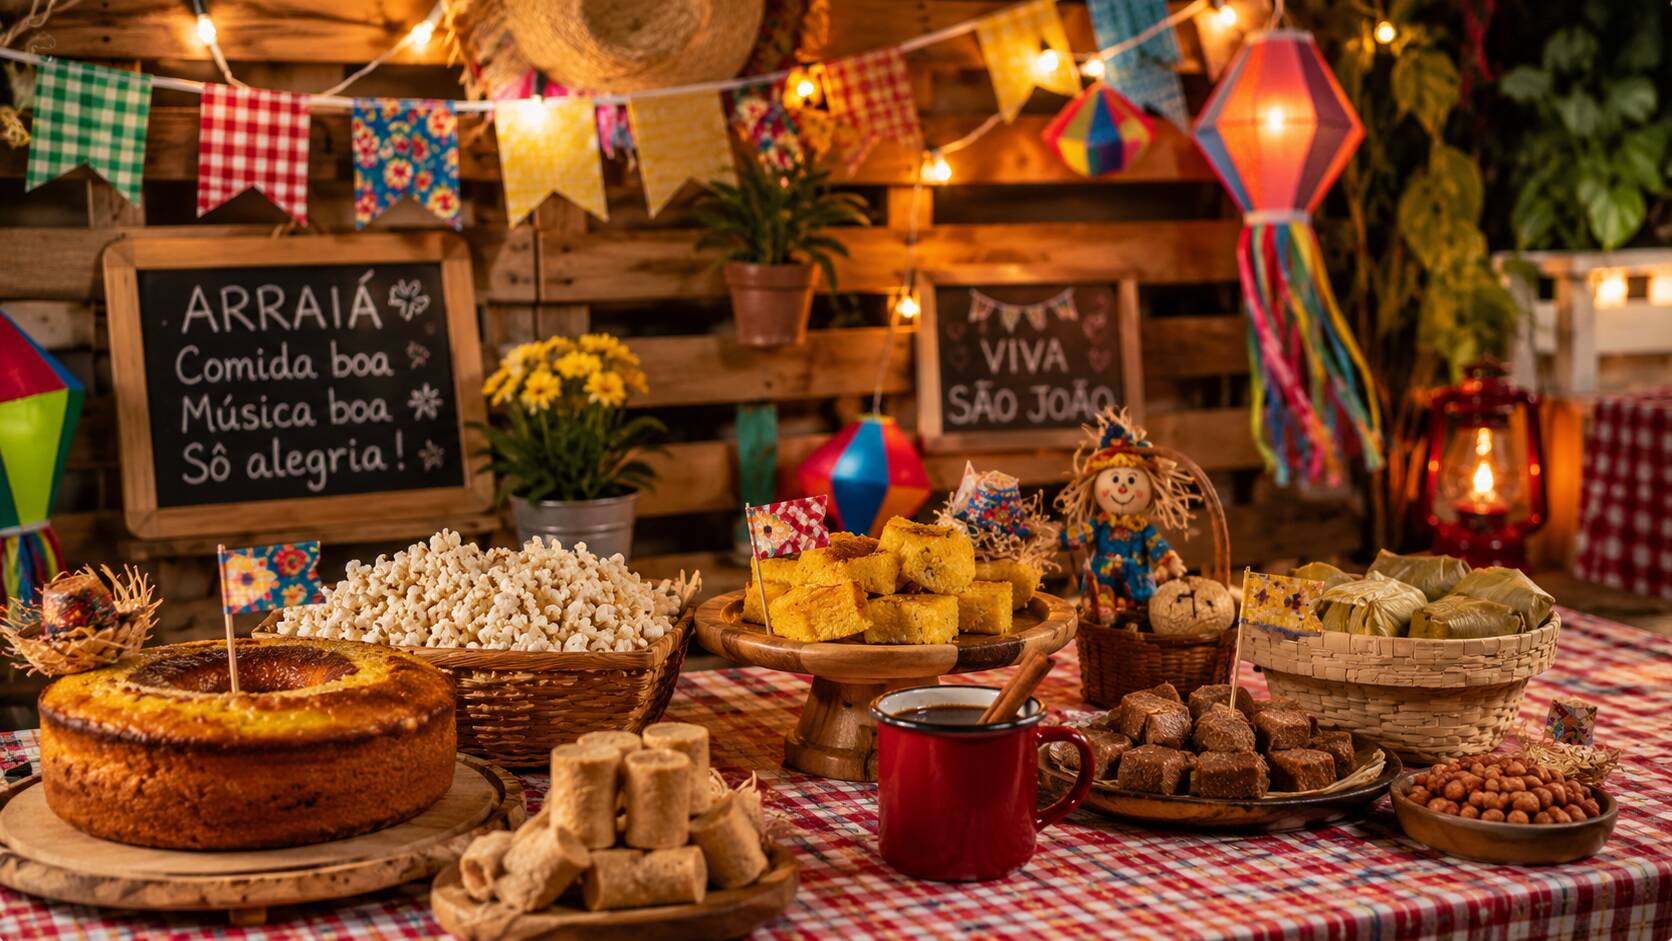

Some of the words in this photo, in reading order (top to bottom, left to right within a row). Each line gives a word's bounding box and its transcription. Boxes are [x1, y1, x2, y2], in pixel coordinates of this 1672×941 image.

[181, 269, 383, 334] ARRAIÁ
[175, 341, 318, 385] Comida
[330, 340, 394, 378] boa
[979, 337, 1068, 374] VIVA
[181, 394, 317, 434] Música
[329, 387, 393, 426] boa
[948, 379, 1018, 425] SÃO
[1027, 378, 1115, 424] JOÃO
